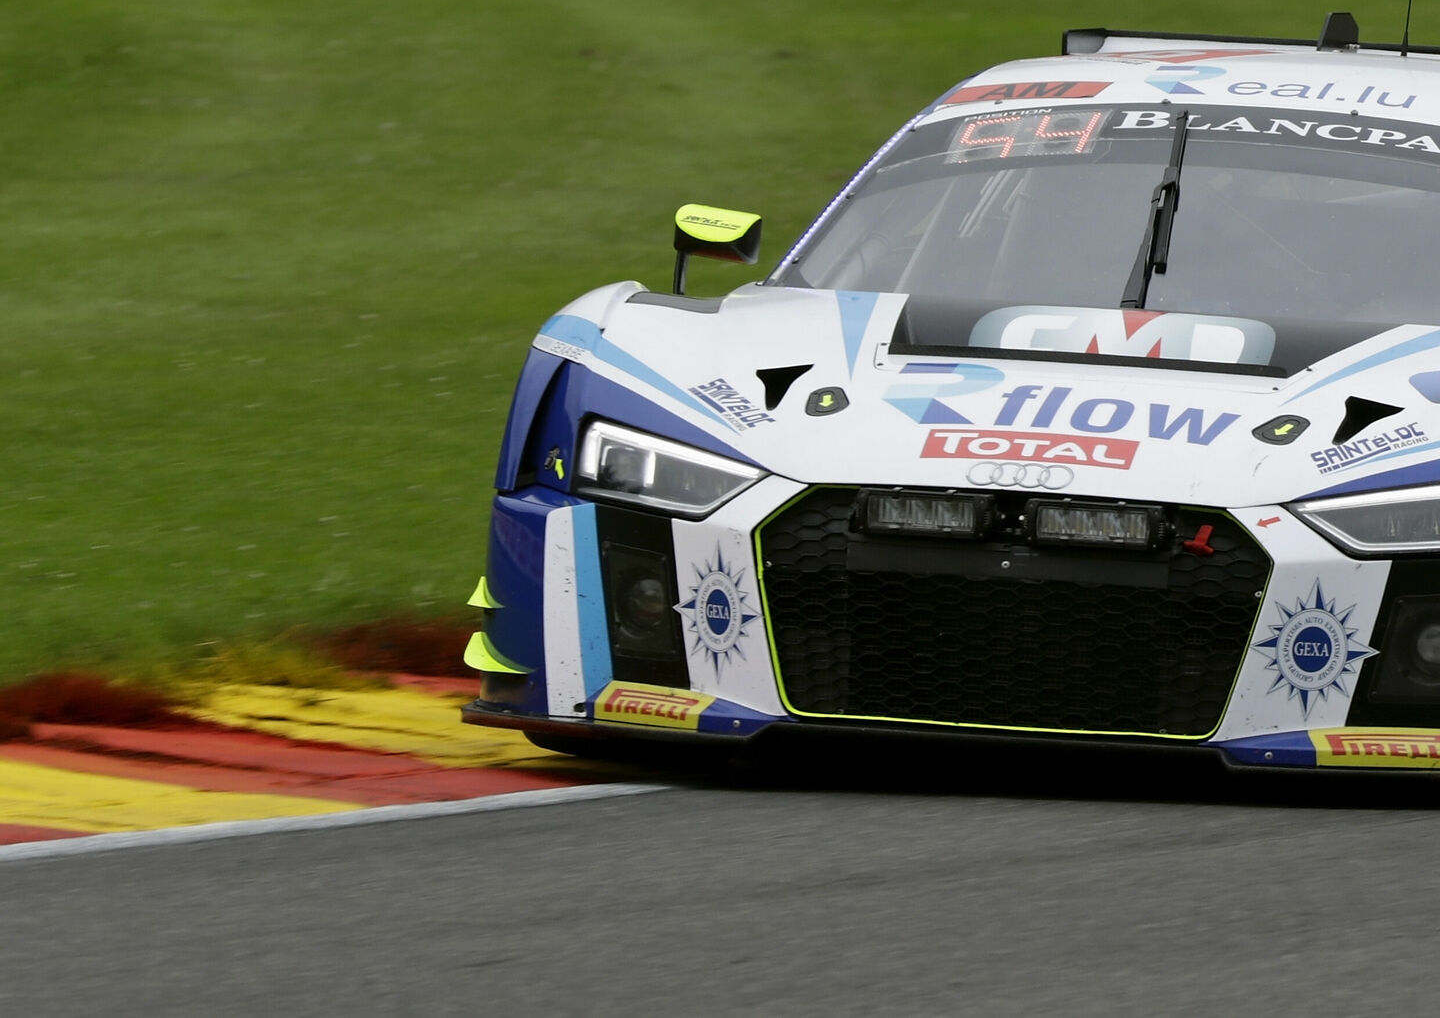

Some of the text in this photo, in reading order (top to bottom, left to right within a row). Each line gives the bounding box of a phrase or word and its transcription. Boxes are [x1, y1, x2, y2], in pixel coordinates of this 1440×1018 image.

[977, 83, 1075, 99] AM
[964, 108, 1053, 122] POSITION
[932, 431, 1128, 465] TOTAL
[1393, 435, 1430, 450] RACING
[706, 603, 730, 620] GEXA
[1305, 616, 1324, 624] AUTO
[1294, 641, 1330, 657] GEXA
[604, 688, 700, 721] PIRELLI
